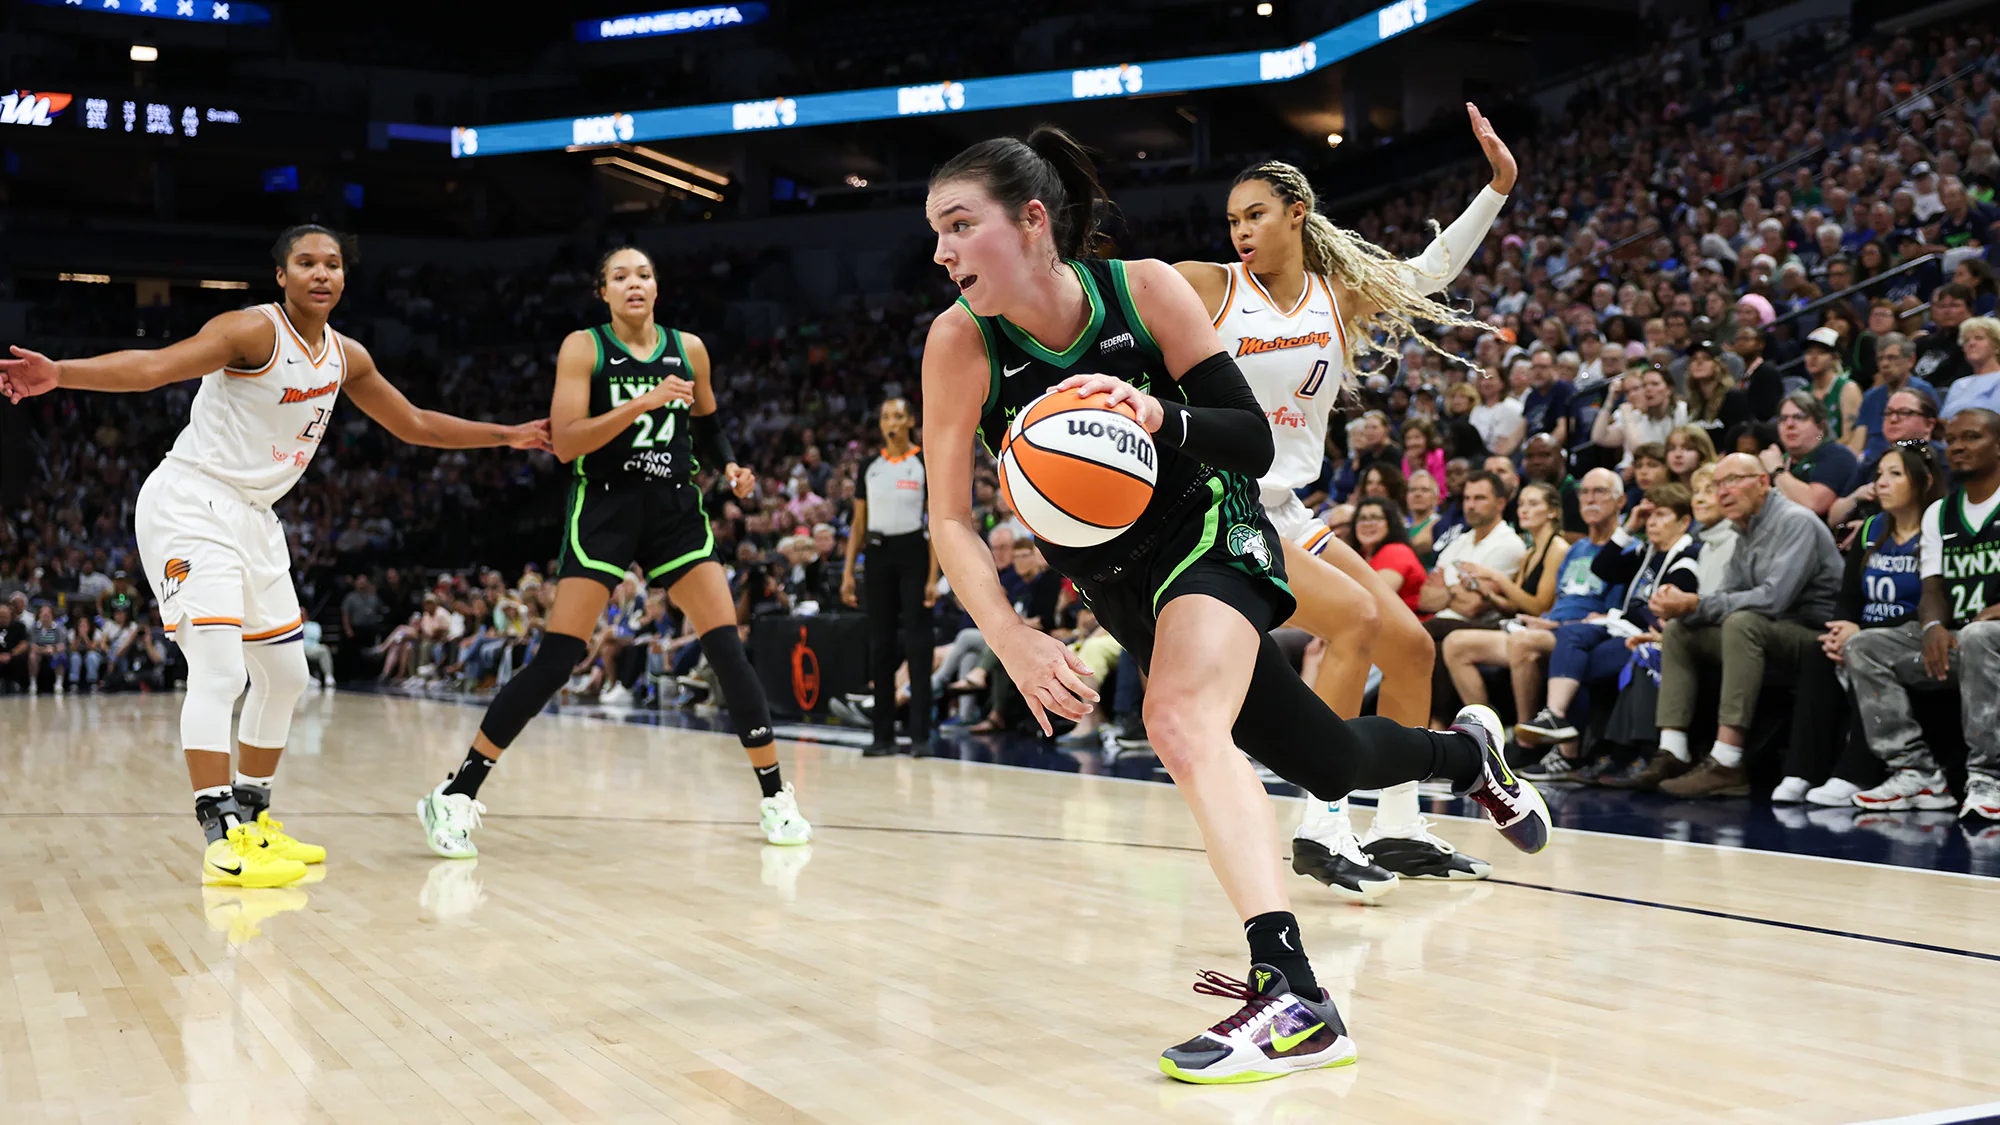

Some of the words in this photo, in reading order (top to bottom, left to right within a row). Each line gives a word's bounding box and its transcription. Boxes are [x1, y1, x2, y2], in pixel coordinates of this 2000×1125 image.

[601, 7, 742, 37] MINNESOTA
[1236, 332, 1331, 357] Mercury
[632, 412, 676, 448] 24
[1067, 419, 1154, 471] Wilson
[1944, 549, 2000, 578] LYNX
[1865, 575, 1897, 604] 10
[1951, 581, 1987, 619] 24
